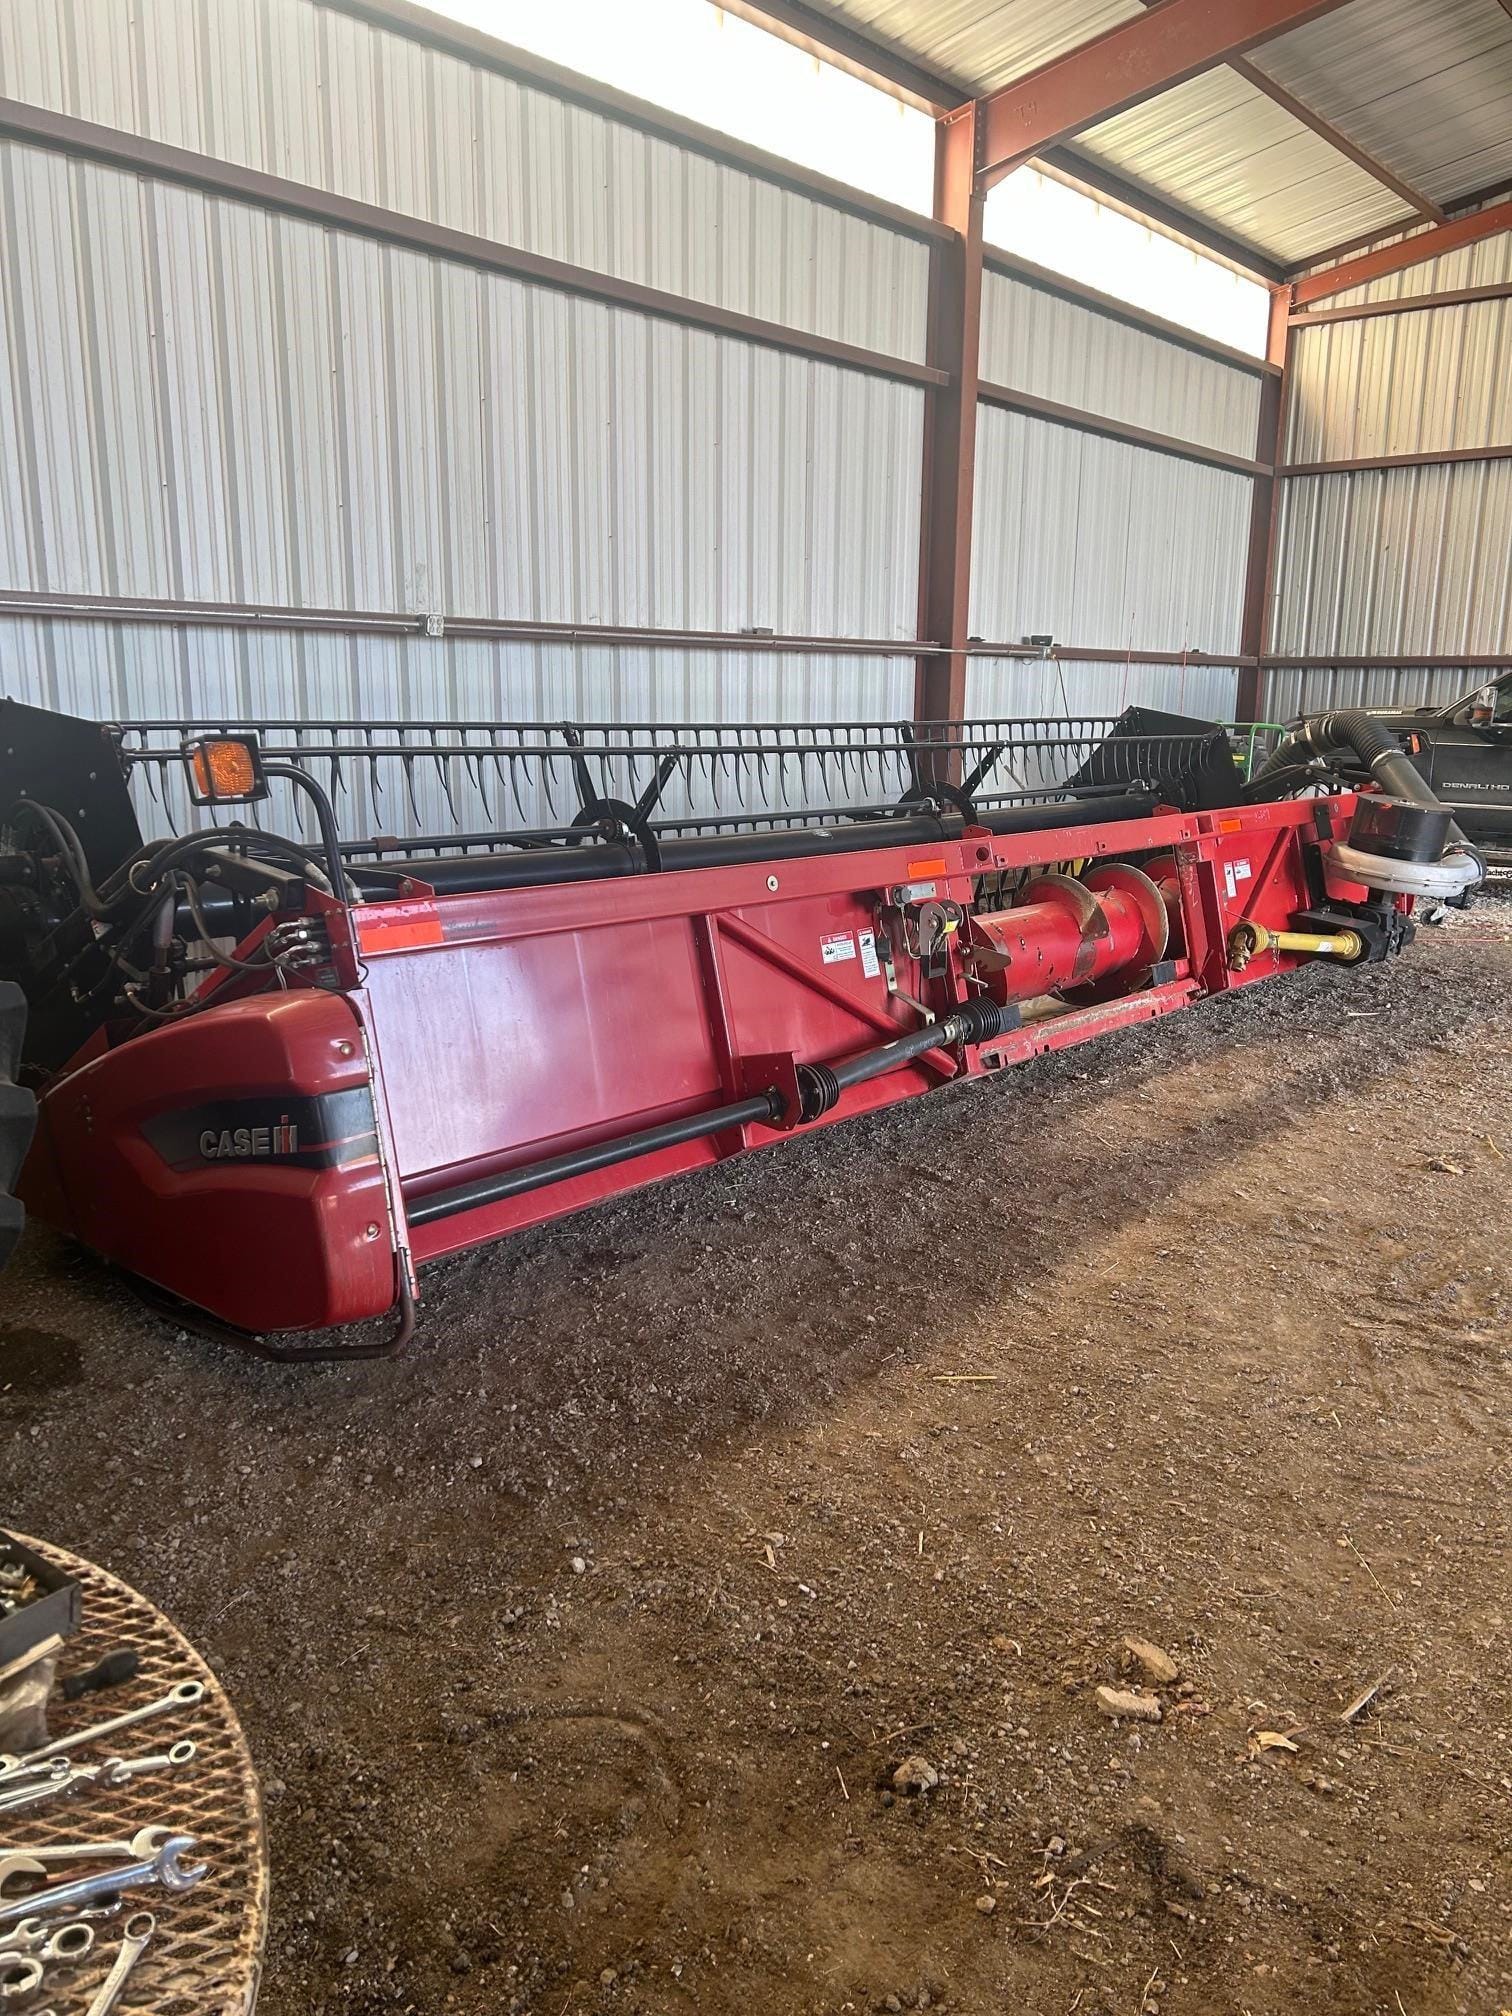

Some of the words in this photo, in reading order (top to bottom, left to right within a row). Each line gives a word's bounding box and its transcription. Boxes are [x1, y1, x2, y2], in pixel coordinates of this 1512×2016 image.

[1442, 782, 1489, 790] DENALI
[1490, 783, 1510, 791] HD
[199, 1127, 271, 1158] CASE
